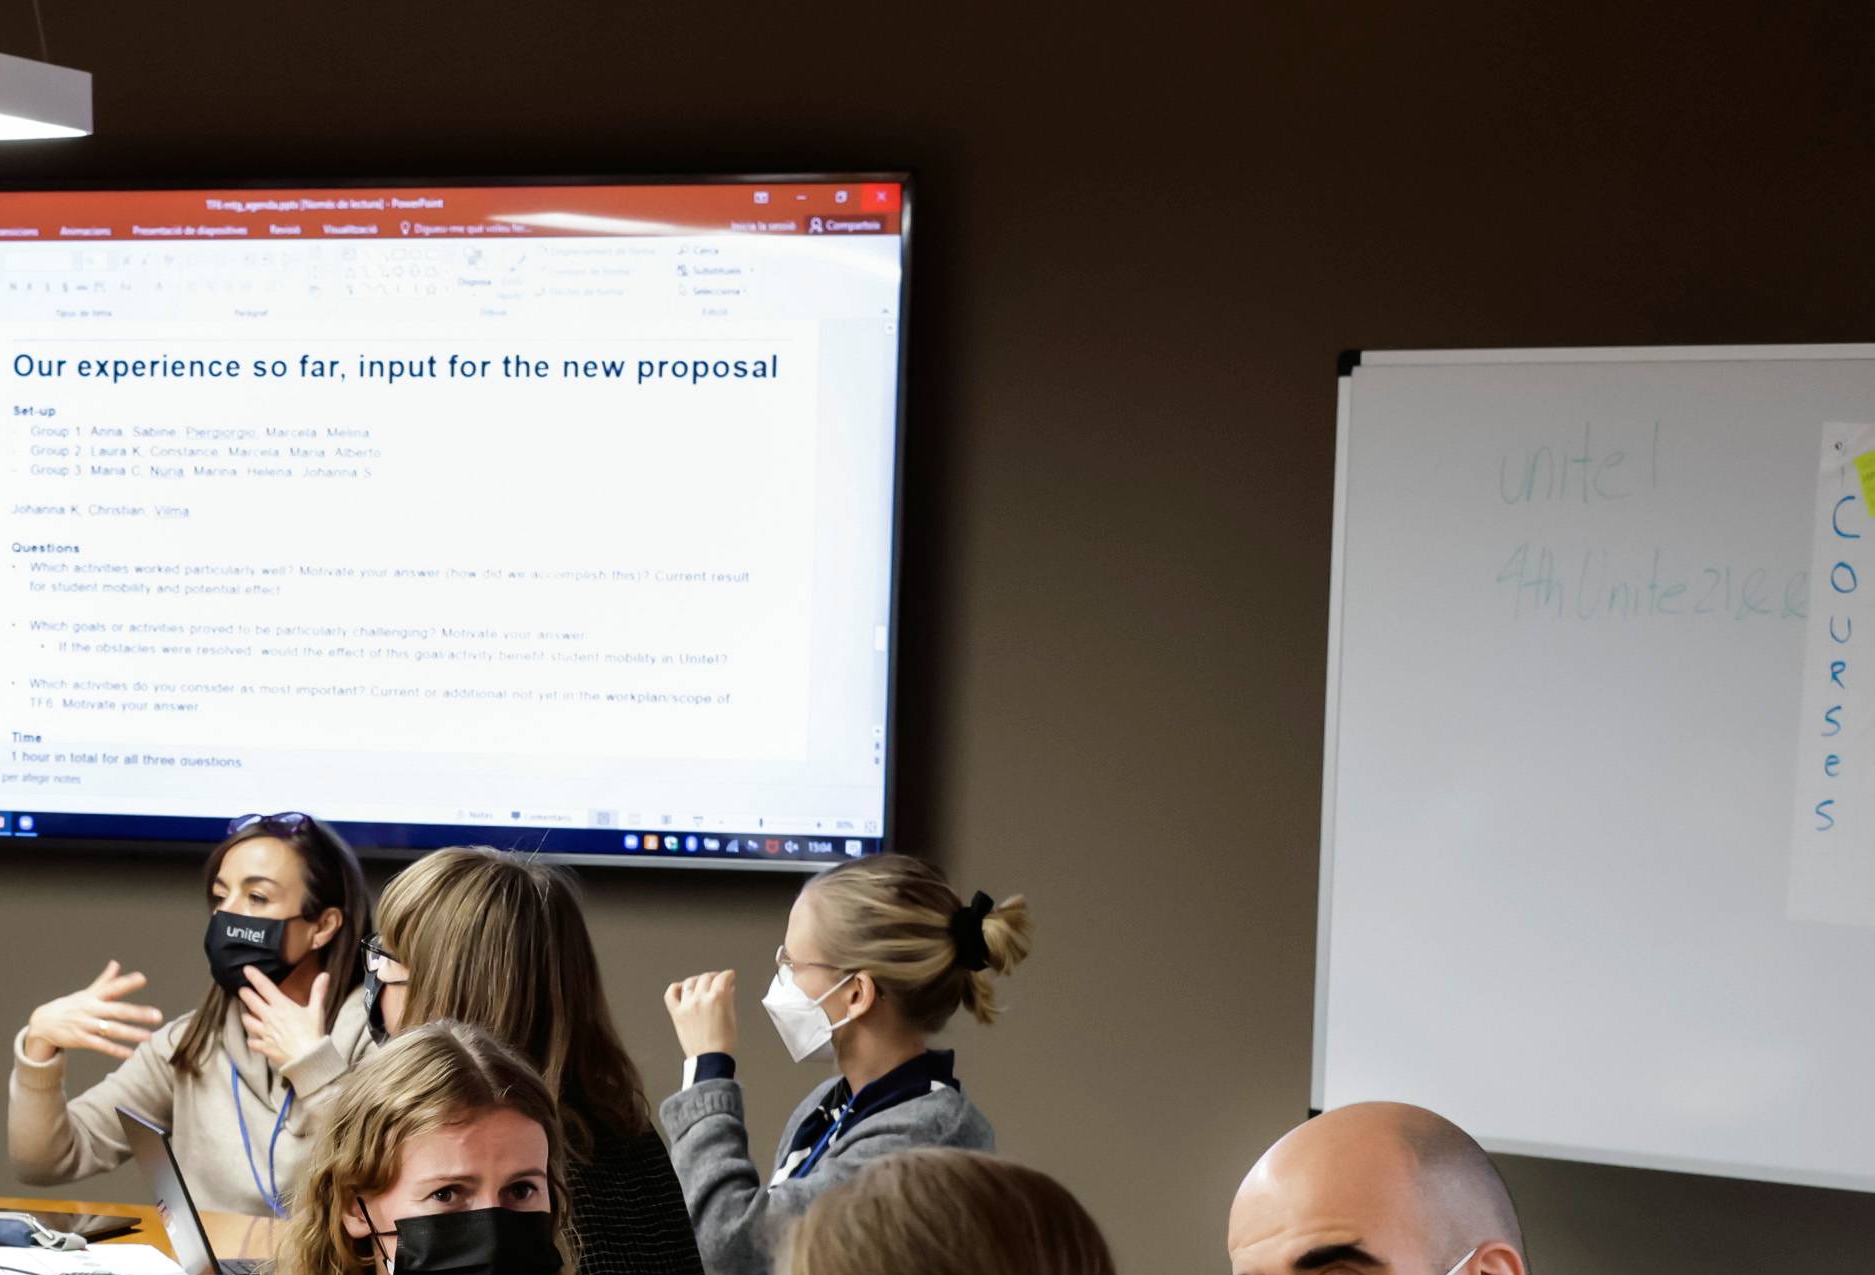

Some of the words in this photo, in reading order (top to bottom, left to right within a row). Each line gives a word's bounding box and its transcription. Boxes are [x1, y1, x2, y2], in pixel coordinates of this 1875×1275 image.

[13, 354, 68, 377] Our
[77, 355, 240, 383] experience
[252, 359, 287, 377] so
[298, 353, 347, 381] far,
[359, 354, 437, 383] input
[448, 353, 491, 377] for
[502, 354, 549, 378] the
[563, 359, 624, 378] new
[637, 354, 778, 384] proposal
[30, 425, 69, 439] Group
[30, 445, 69, 458] Group
[91, 446, 127, 457] Laura
[334, 447, 382, 458] Alberto
[30, 464, 69, 477] Group
[11, 504, 66, 515] Johanna
[11, 542, 80, 554] Questions
[29, 562, 69, 574] Which
[73, 563, 129, 574] activities
[133, 563, 180, 575] worked
[184, 564, 255, 578] particularly
[299, 566, 355, 577] Motivate
[358, 568, 388, 580] your
[393, 569, 440, 579] answer
[482, 569, 502, 579] did
[508, 571, 525, 579] we
[531, 569, 606, 582] accomplish
[655, 570, 707, 582] Current
[711, 572, 750, 583] result
[29, 580, 46, 592] for
[50, 581, 99, 593] student
[102, 582, 151, 596] mobility
[156, 583, 180, 594] and
[184, 583, 240, 596] potential
[28, 620, 68, 632] Which
[72, 621, 107, 635] goals
[111, 623, 124, 632] or
[129, 622, 185, 633] activities
[189, 624, 234, 636] proved
[238, 625, 250, 634] to
[255, 625, 271, 635] be
[276, 625, 347, 639] particularly
[440, 627, 498, 640] Motivate
[503, 630, 532, 641] your
[58, 641, 67, 652] If
[71, 641, 91, 652] the
[95, 643, 156, 654] obstacles
[161, 646, 192, 654] were
[261, 646, 298, 657] would
[303, 647, 323, 657] the
[328, 647, 364, 658] effect
[369, 648, 382, 659] of
[385, 649, 410, 660] this
[498, 650, 545, 662] benefit
[549, 651, 600, 662] student
[604, 652, 655, 666] mobility
[660, 654, 674, 664] in
[28, 678, 68, 689] Which
[72, 680, 128, 691] activities
[133, 681, 148, 691] do
[153, 683, 175, 695] you
[180, 683, 234, 694] consider
[240, 685, 254, 694] as
[259, 684, 291, 694] most
[370, 686, 420, 697] Current
[424, 689, 436, 697] or
[442, 688, 507, 699] additional
[512, 689, 533, 699] not
[537, 690, 558, 702] yet
[563, 691, 574, 700] in
[579, 690, 600, 701] the
[716, 693, 731, 704] of
[62, 698, 116, 710] Motivate
[121, 701, 148, 713] your
[11, 730, 43, 743] Time
[21, 751, 51, 763] hour
[54, 752, 67, 763] in
[70, 752, 99, 764] total
[102, 752, 120, 764] for
[124, 754, 139, 765] all
[142, 754, 176, 766] three
[2, 773, 19, 784] per
[53, 775, 81, 785] notes
[226, 926, 265, 943] unite!
